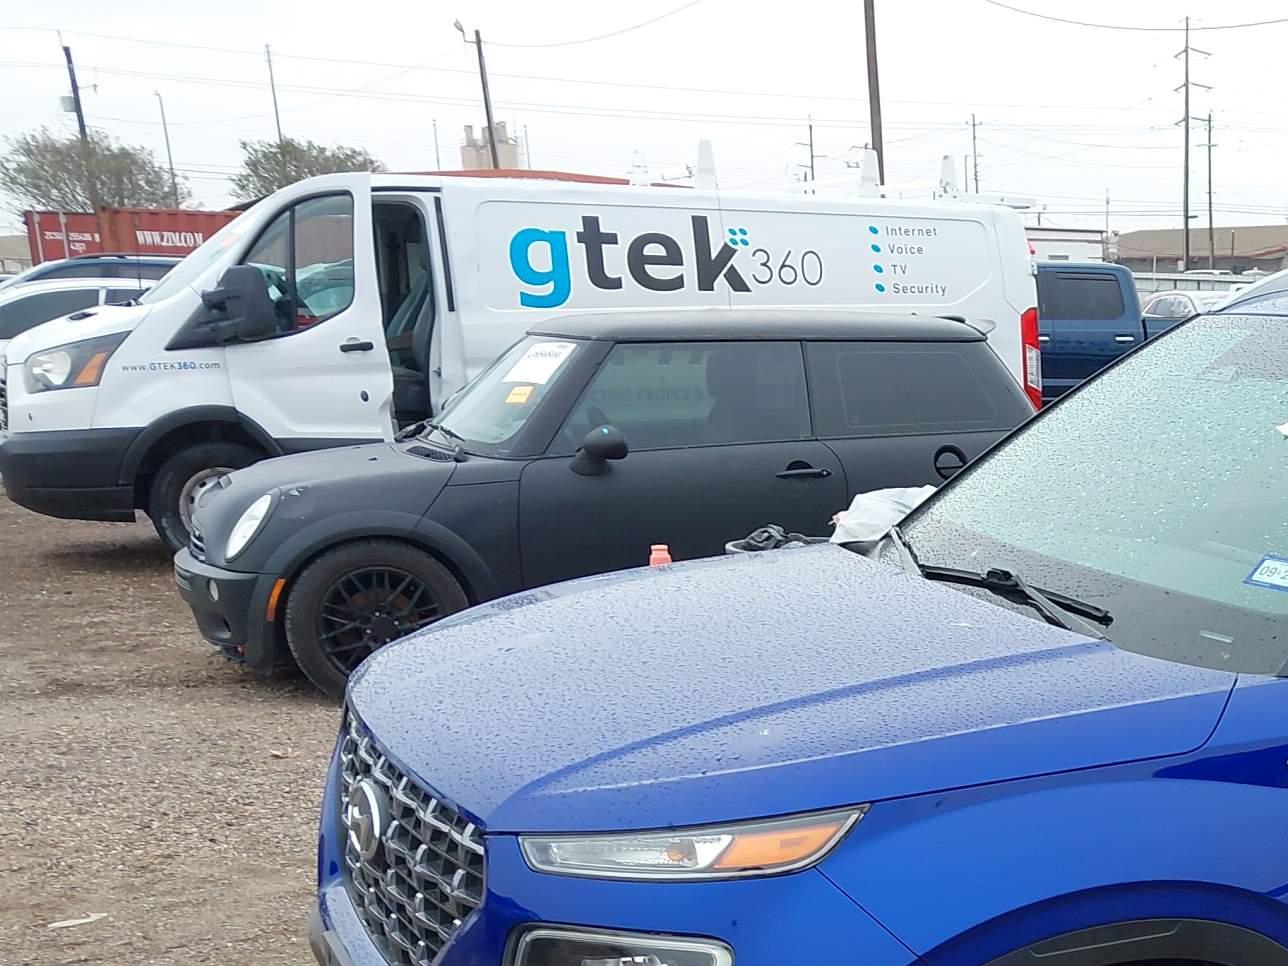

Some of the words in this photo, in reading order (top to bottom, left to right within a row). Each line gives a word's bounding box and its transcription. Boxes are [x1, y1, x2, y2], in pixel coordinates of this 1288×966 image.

[885, 225, 938, 237] Internet
[887, 243, 924, 255] Voice
[890, 263, 907, 275] TV
[892, 282, 947, 297] Security
[121, 361, 221, 372] www.GTEK360.com
